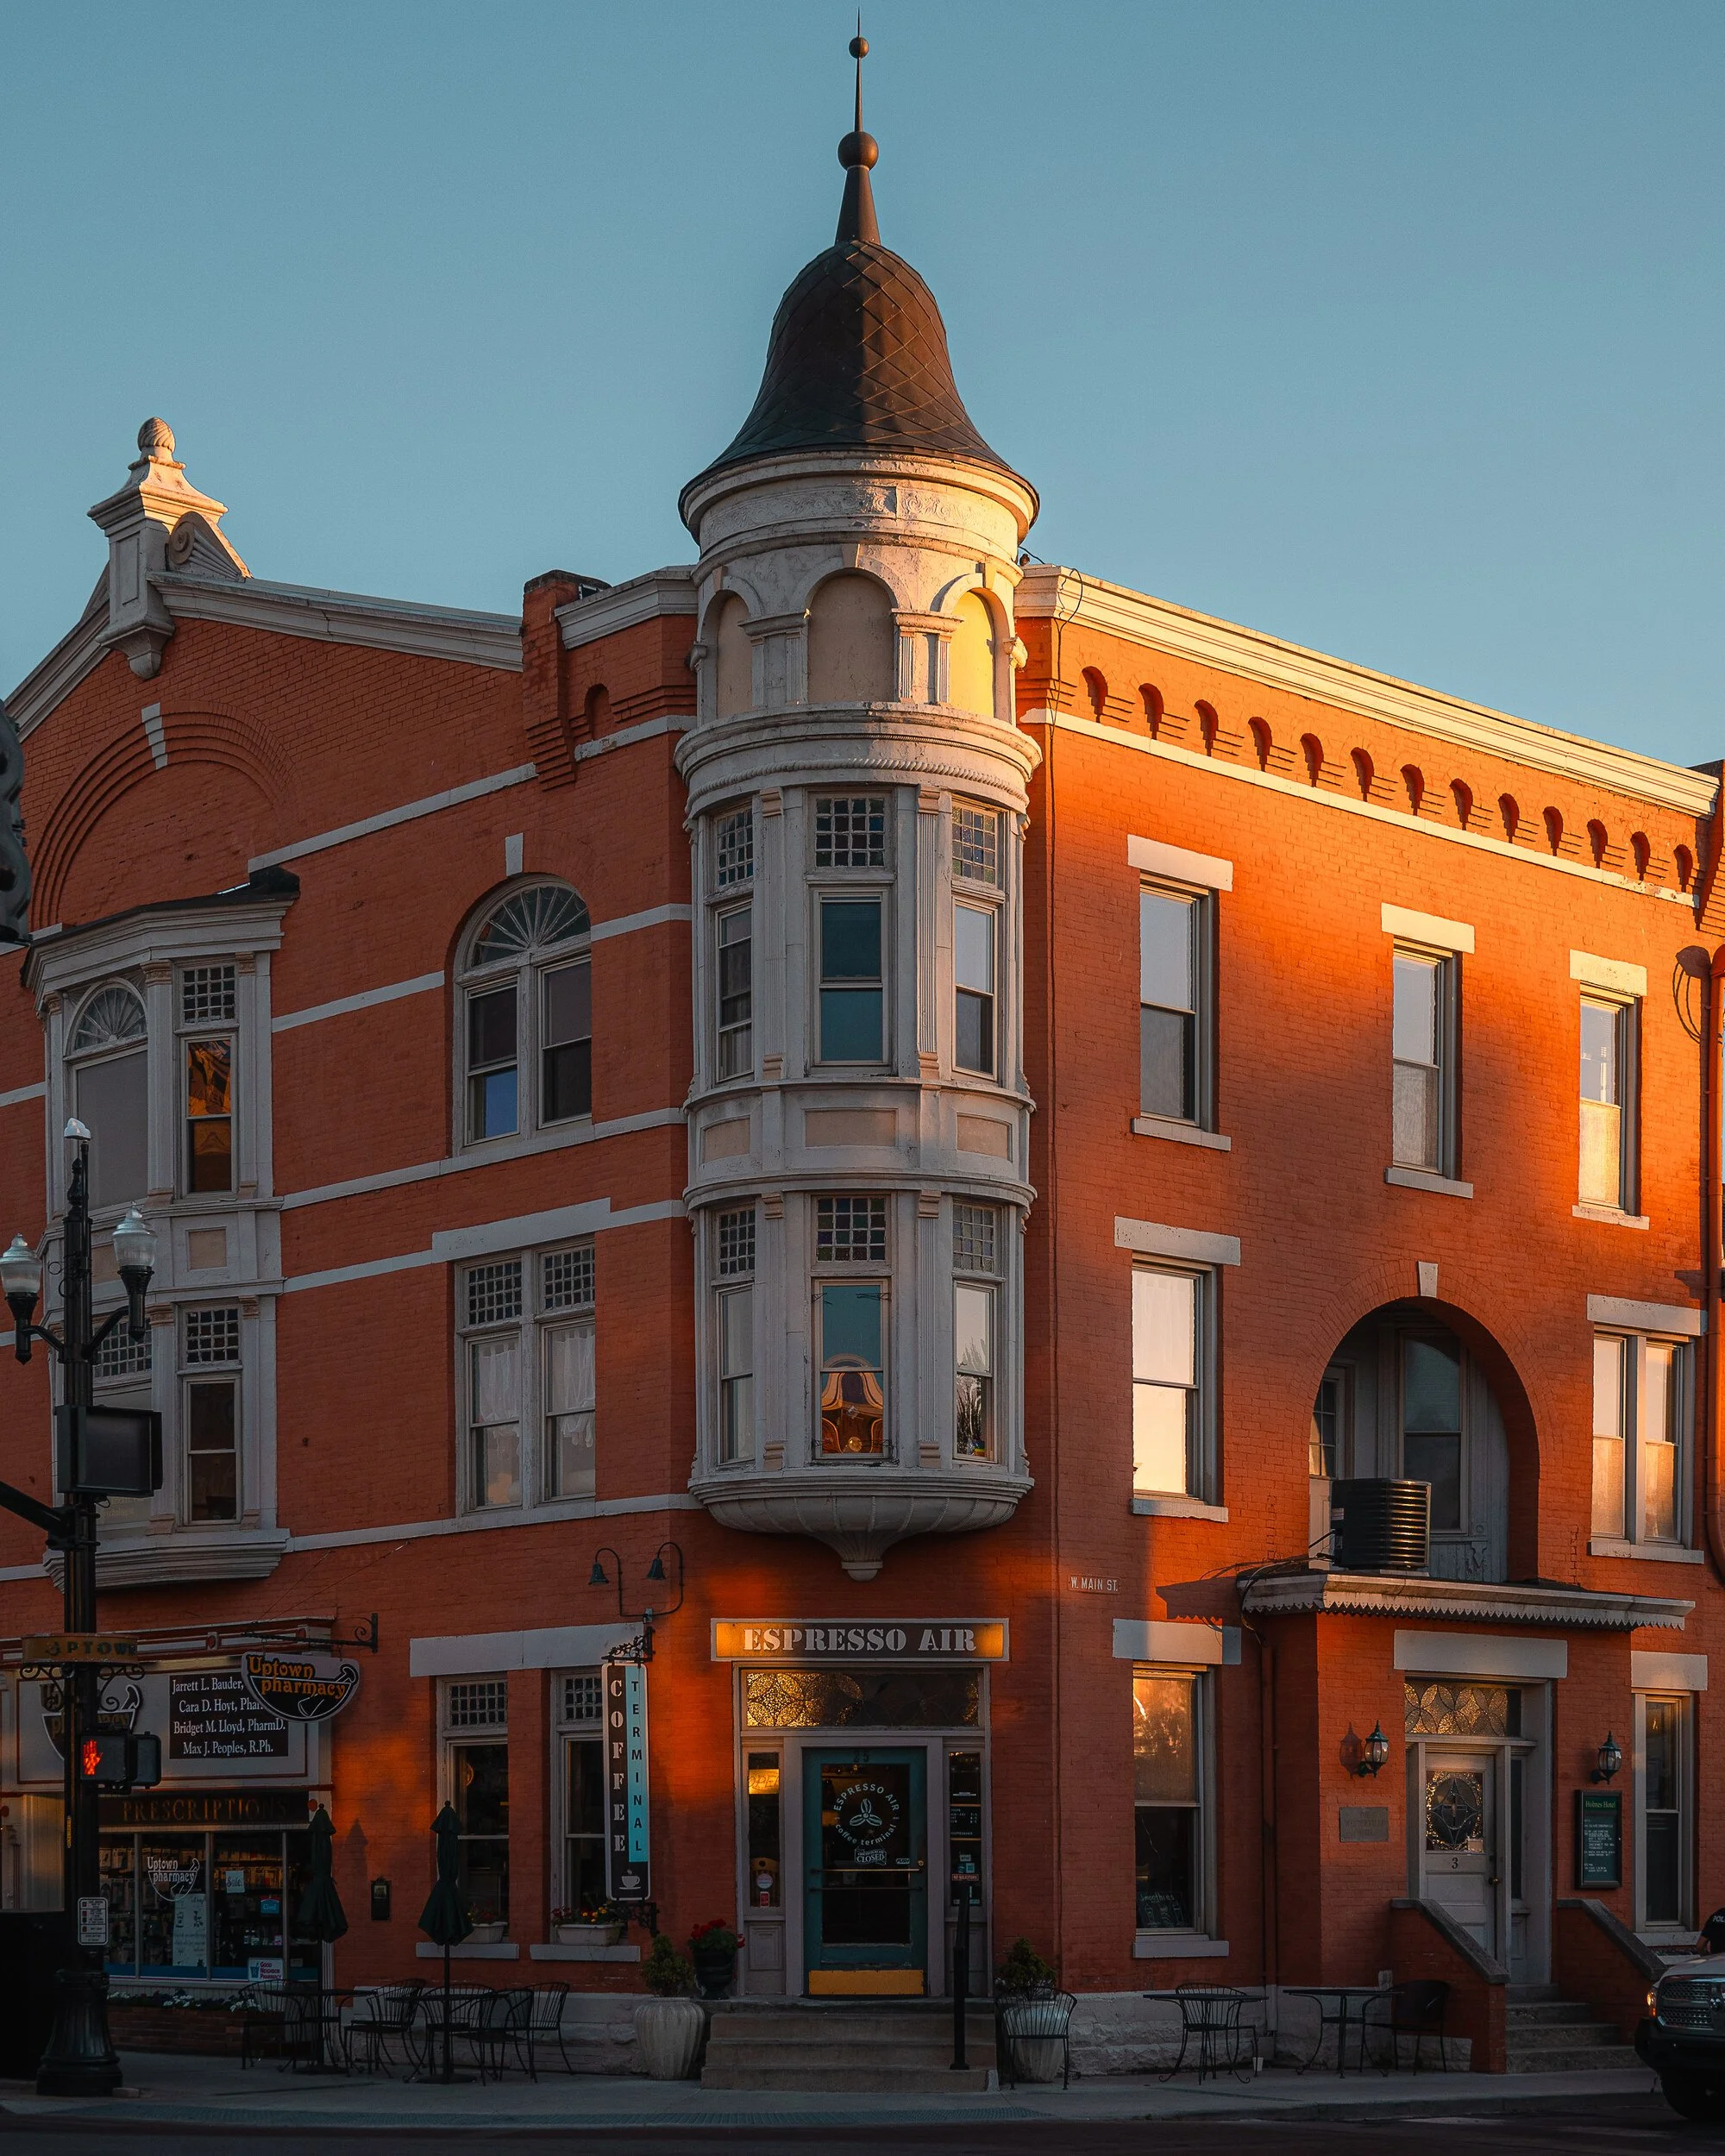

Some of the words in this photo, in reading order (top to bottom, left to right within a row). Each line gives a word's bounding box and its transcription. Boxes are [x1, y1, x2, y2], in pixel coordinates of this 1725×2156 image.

[1070, 1576, 1079, 1589] W.
[1081, 1577, 1103, 1590] MAIN
[1107, 1579, 1119, 1591] ST.
[743, 1628, 906, 1651] ESPRESSO
[918, 1628, 976, 1651] AIR
[248, 1656, 315, 1680] Uptown
[172, 1679, 198, 1694] Jarrett
[200, 1679, 210, 1690] L.
[211, 1677, 244, 1691] Bauder,
[260, 1678, 346, 1700] pharmacy
[179, 1700, 200, 1713] Cara
[201, 1700, 211, 1712] D.
[214, 1699, 238, 1714] Hoyt,
[173, 1720, 204, 1736] Bridget
[205, 1720, 216, 1733] M.
[218, 1719, 245, 1735] Lloyd,
[248, 1718, 286, 1732] PharmD.
[183, 1741, 202, 1755] Max
[204, 1741, 211, 1757] J.
[212, 1740, 247, 1757] Peoples,
[249, 1739, 273, 1752] R.Ph.
[610, 1680, 625, 1852] COFFEE
[631, 1681, 643, 1852] TERMINAL
[833, 1783, 885, 1811] ESPRESSO
[885, 1794, 900, 1811] AIR
[122, 1797, 287, 1822] PRESCRIPTIONS
[835, 1824, 858, 1844] coffee
[861, 1823, 897, 1846] terminal
[147, 1856, 179, 1871] Uptown
[856, 1853, 885, 1863] CLOSED
[1452, 1857, 1458, 1870] 3
[153, 1871, 195, 1885] pharmacy
[1138, 1892, 1175, 1902] Smoothies
